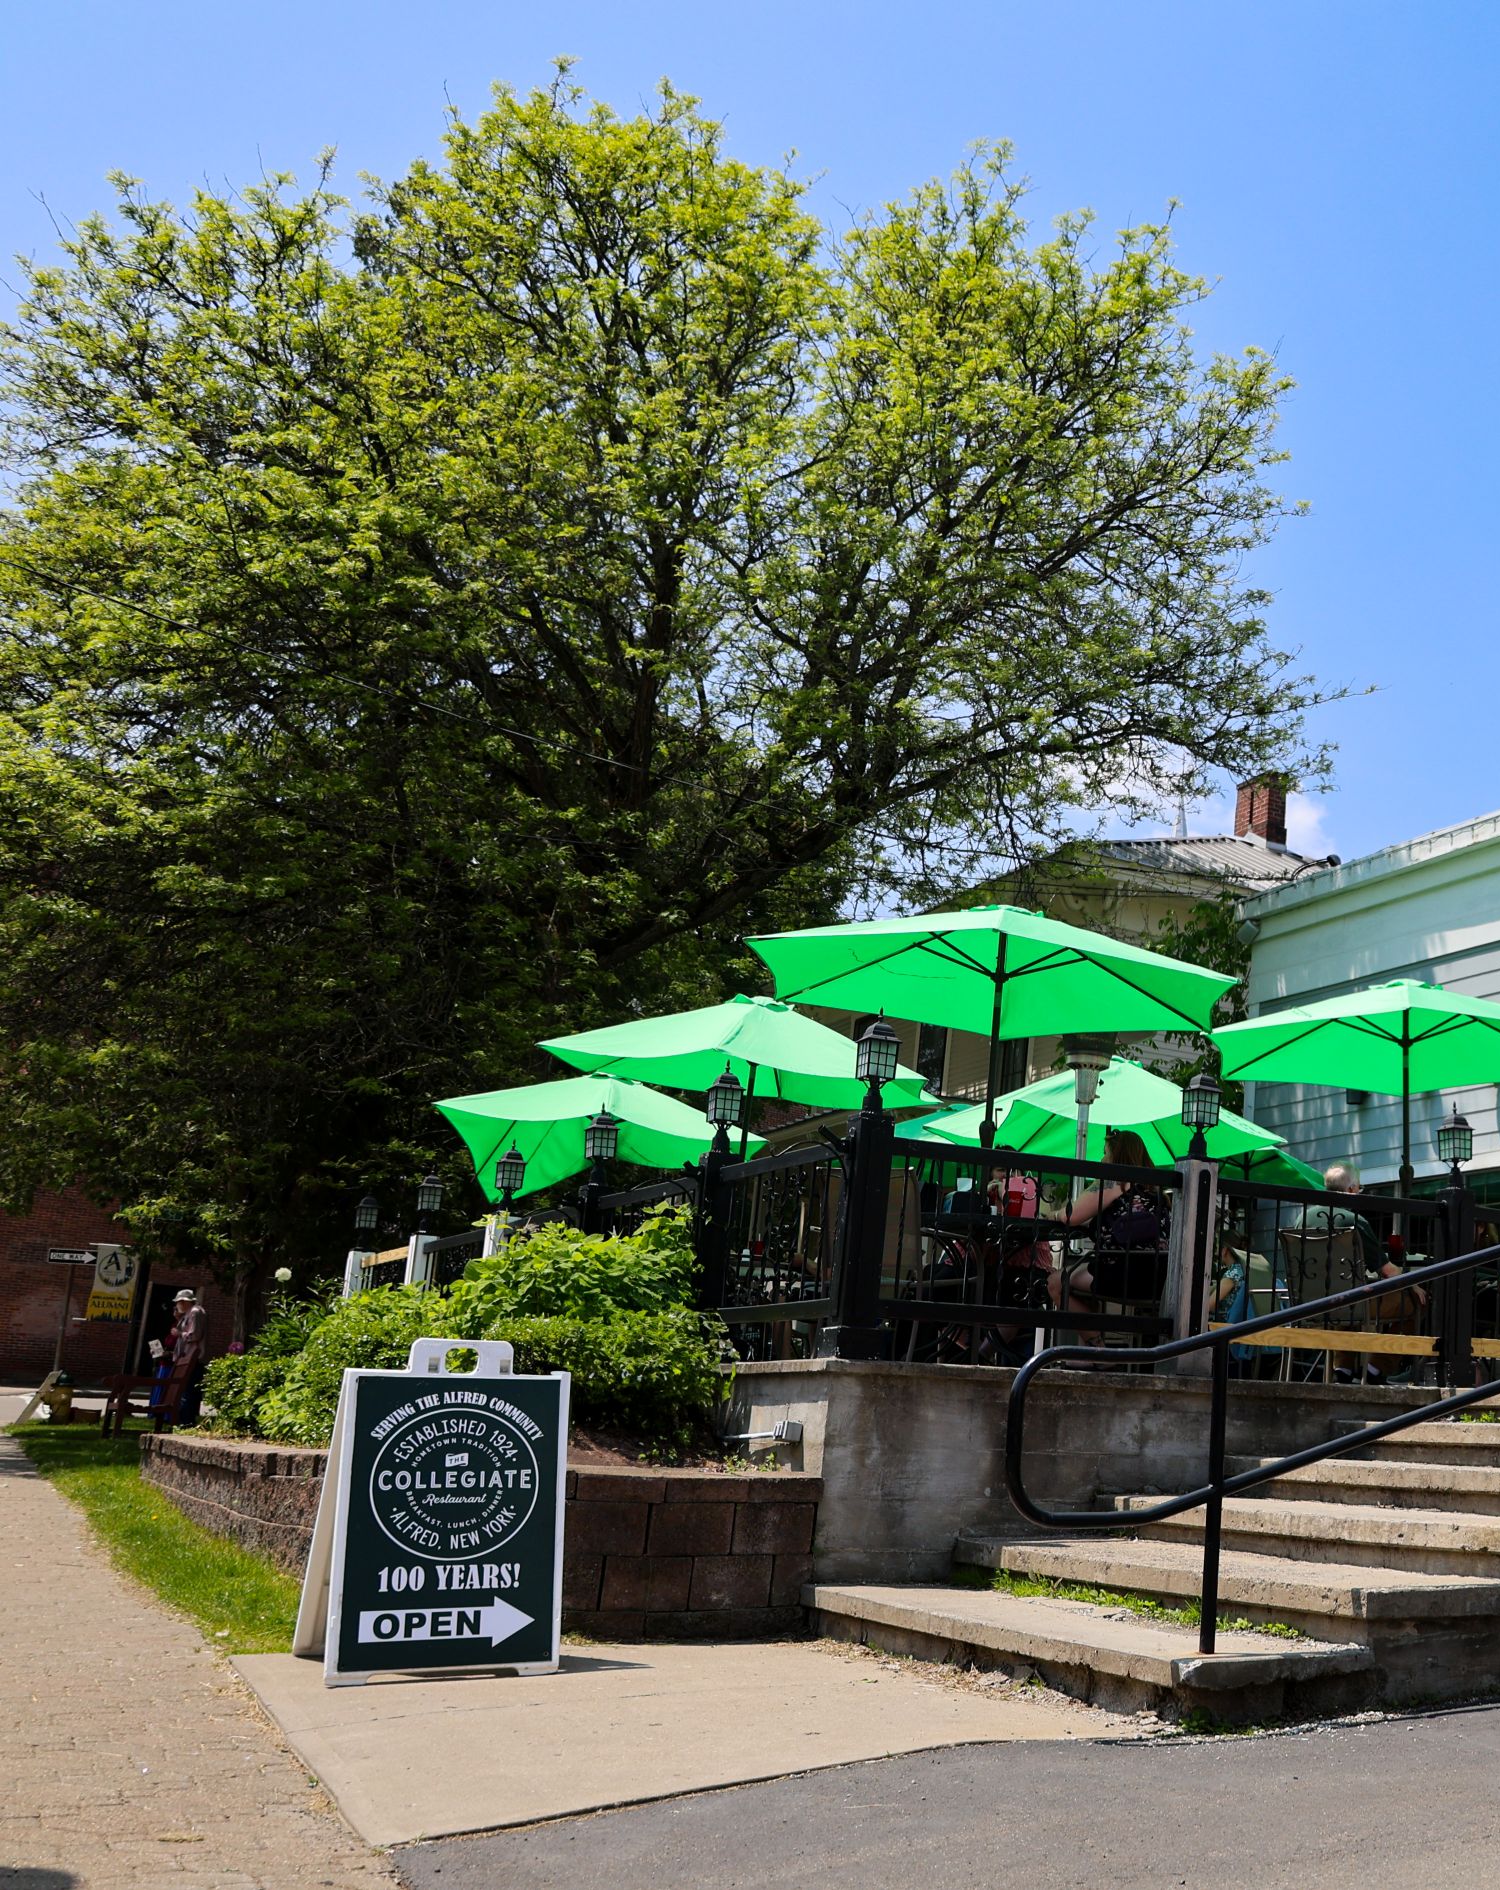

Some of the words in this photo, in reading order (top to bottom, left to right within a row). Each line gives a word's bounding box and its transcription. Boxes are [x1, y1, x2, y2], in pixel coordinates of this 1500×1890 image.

[91, 1300, 129, 1309] ALUMNI
[370, 1403, 416, 1441] SERVING
[415, 1393, 441, 1411] THE
[443, 1391, 488, 1405] ALFRED
[489, 1397, 544, 1442] COMMUNITY
[393, 1419, 487, 1460] ESTABLISHED
[488, 1430, 518, 1459] 1924
[411, 1437, 457, 1468] HOMETOWN
[462, 1437, 501, 1468] TRADITION
[378, 1469, 532, 1491] COLLEGIATE
[422, 1493, 487, 1507] Restaurant
[482, 1489, 504, 1518] DINNER
[450, 1530, 481, 1550] NEW
[481, 1507, 517, 1538] YORK
[377, 1566, 425, 1593] 100
[436, 1563, 521, 1591] YEARS!
[372, 1609, 482, 1640] OPEN
